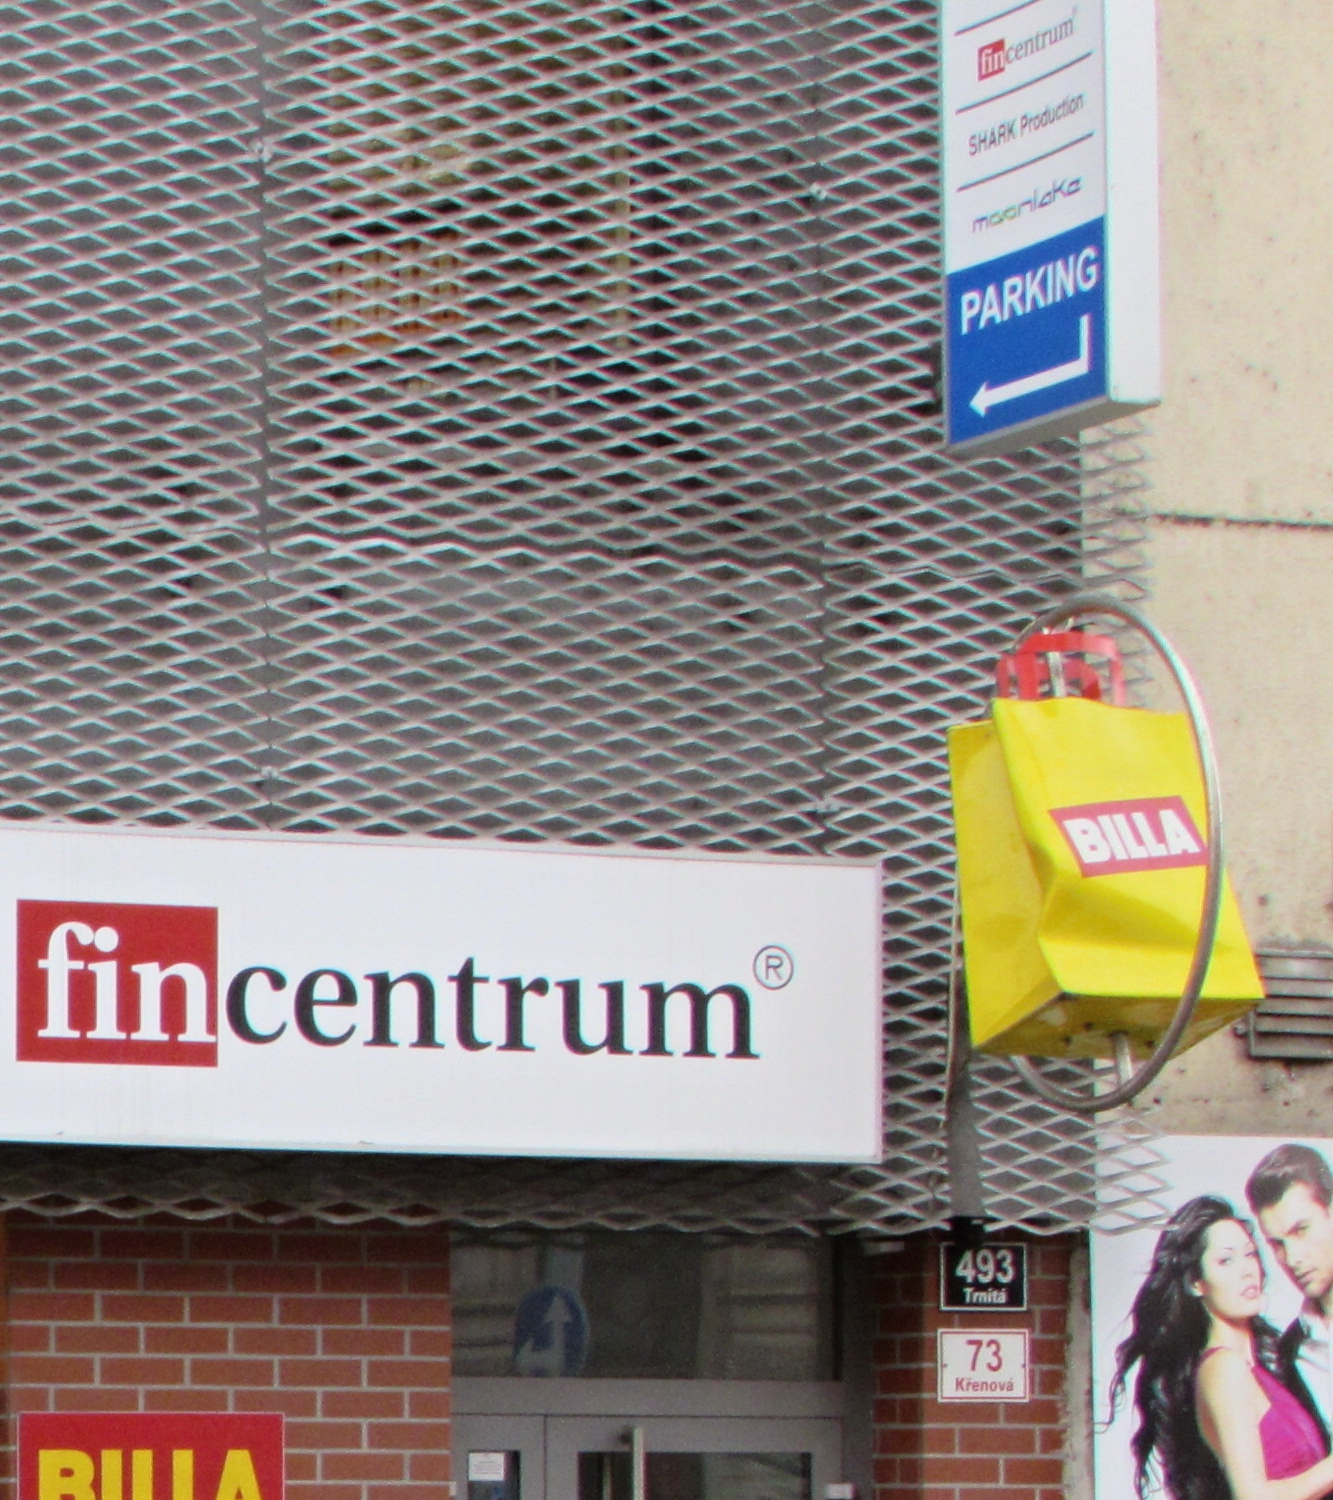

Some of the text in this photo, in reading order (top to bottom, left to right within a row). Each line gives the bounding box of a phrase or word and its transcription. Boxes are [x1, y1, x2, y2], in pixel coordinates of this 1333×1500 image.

[968, 94, 1084, 156] SHARK Production
[961, 245, 1099, 335] PARKING
[1062, 809, 1201, 863] BILLA
[955, 1249, 1015, 1283] 493
[963, 1287, 1007, 1304] Trnitá
[966, 1339, 1003, 1372] 73
[955, 1377, 1014, 1392] Křenová
